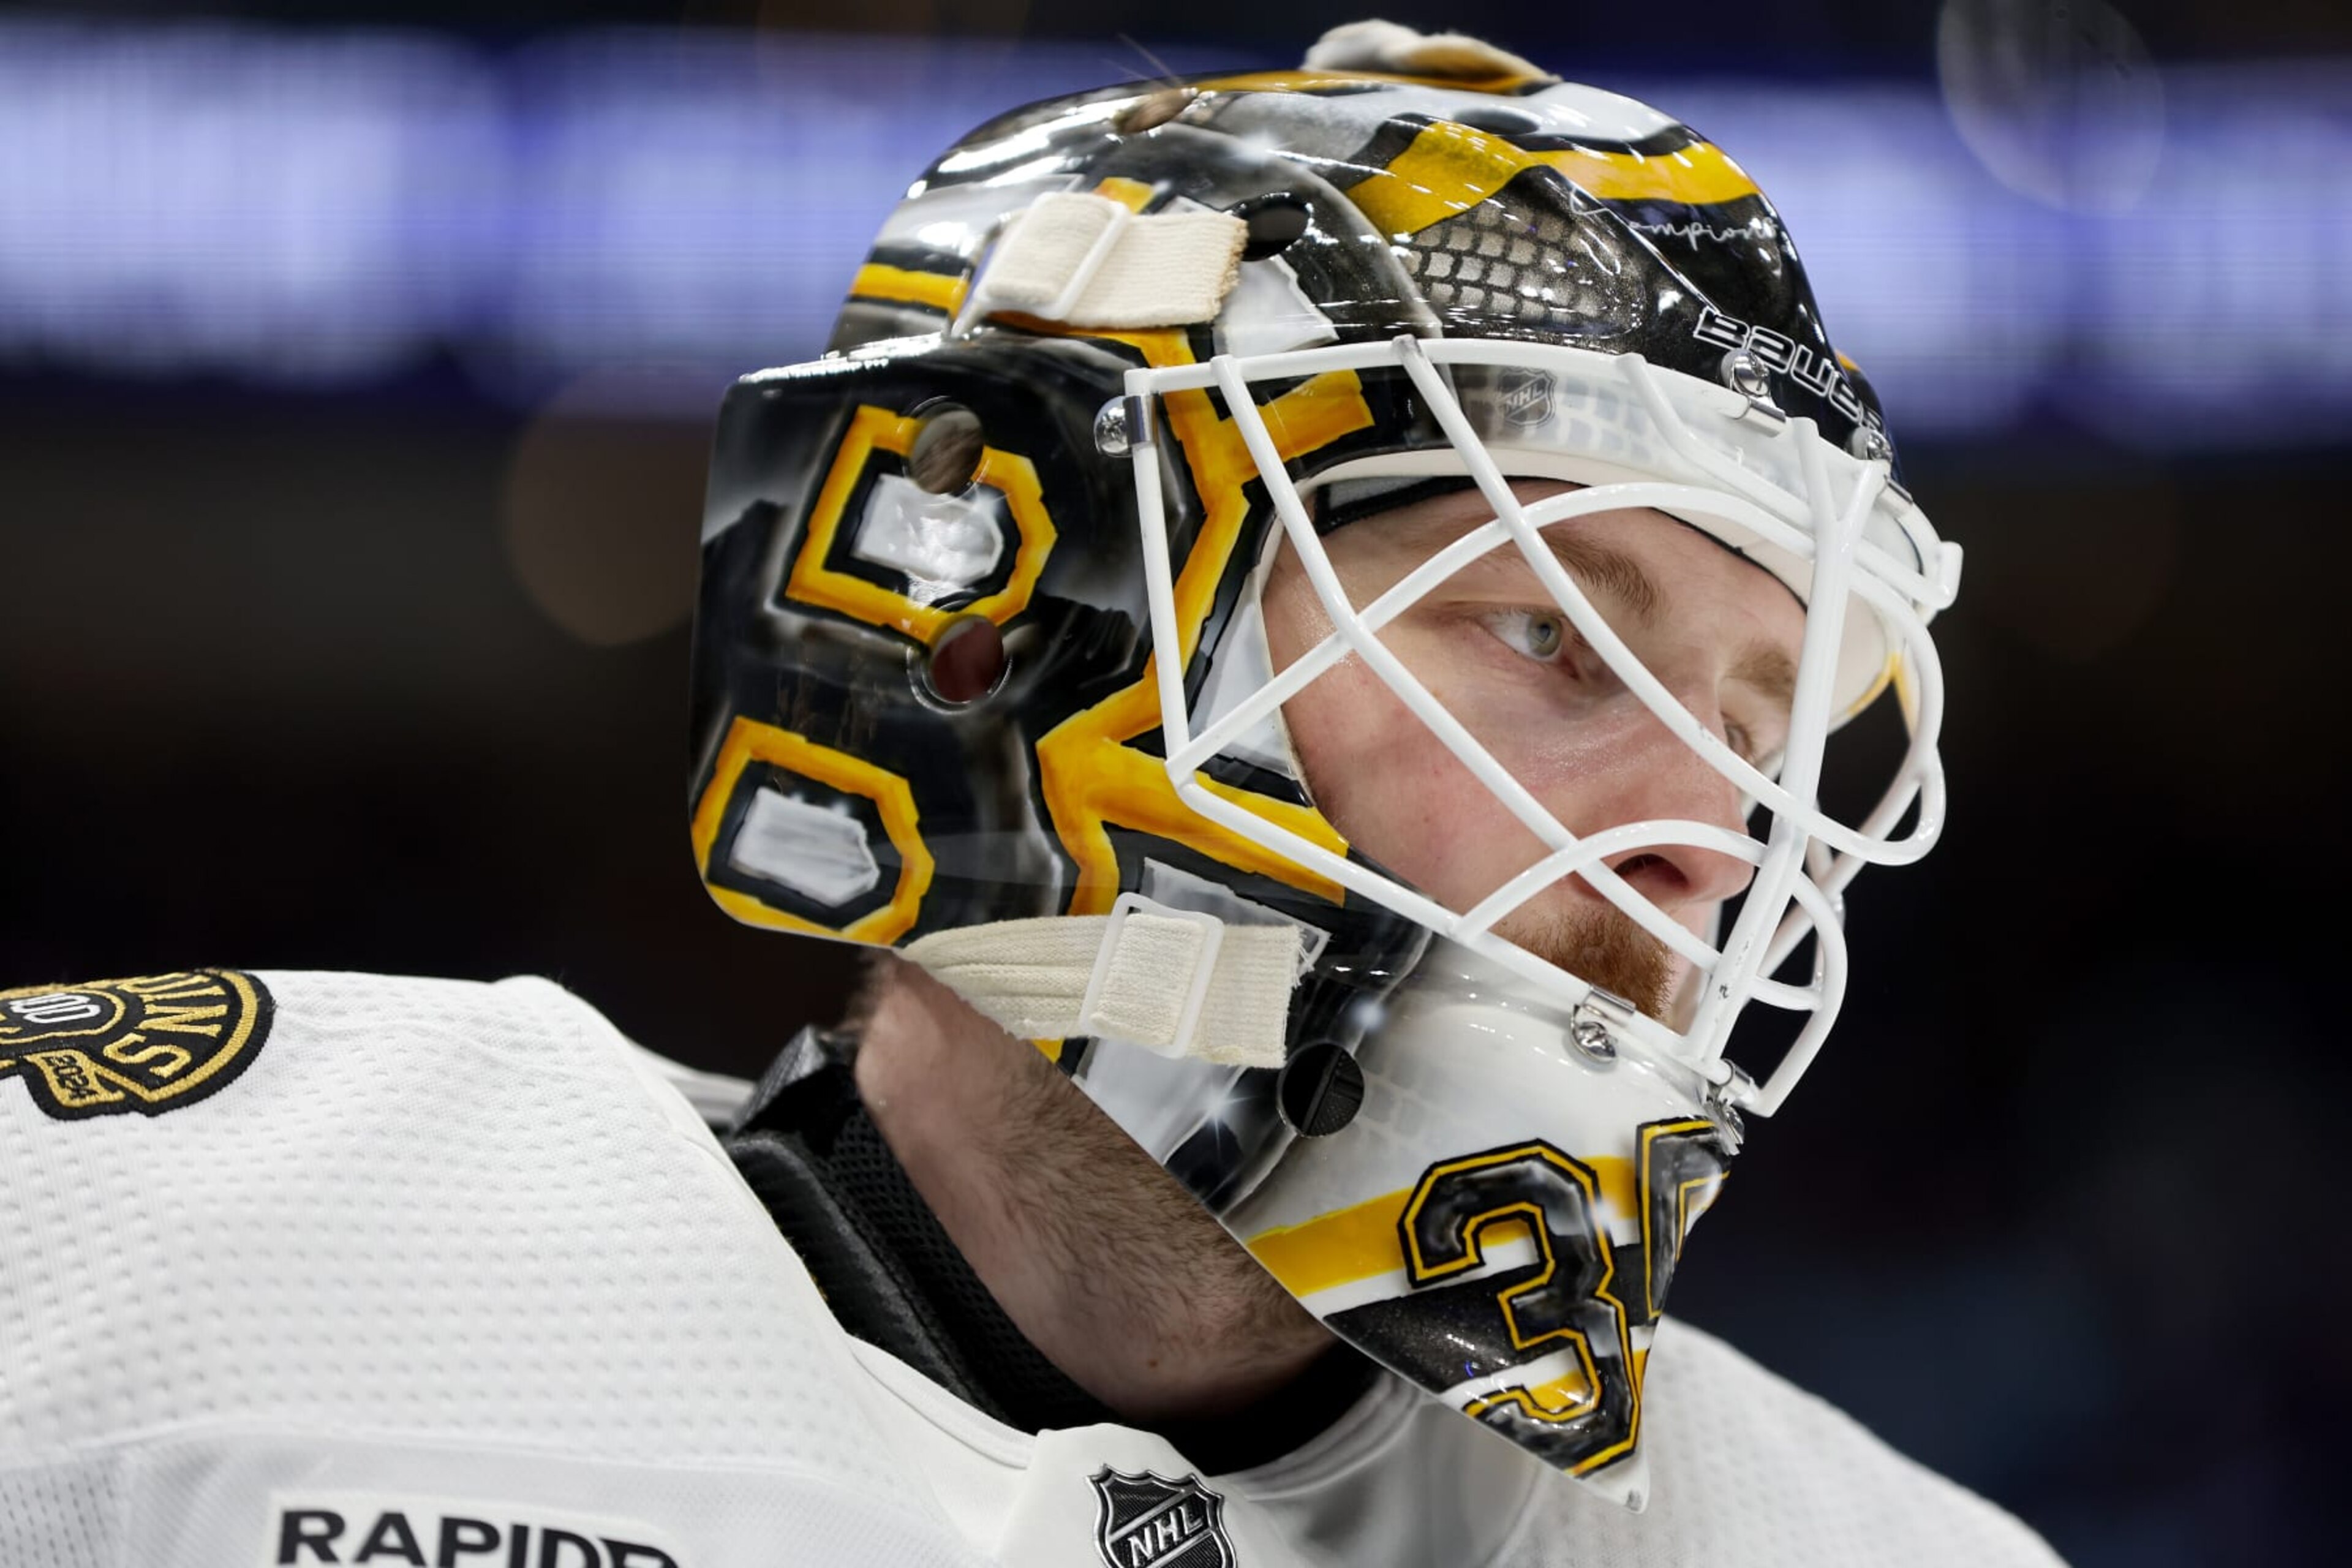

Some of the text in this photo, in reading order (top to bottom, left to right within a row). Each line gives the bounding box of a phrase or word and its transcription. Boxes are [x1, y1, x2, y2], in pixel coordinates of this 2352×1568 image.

[1505, 383, 1544, 414] NHL
[41, 1054, 99, 1100] 2024
[1128, 1502, 1205, 1567] NHL
